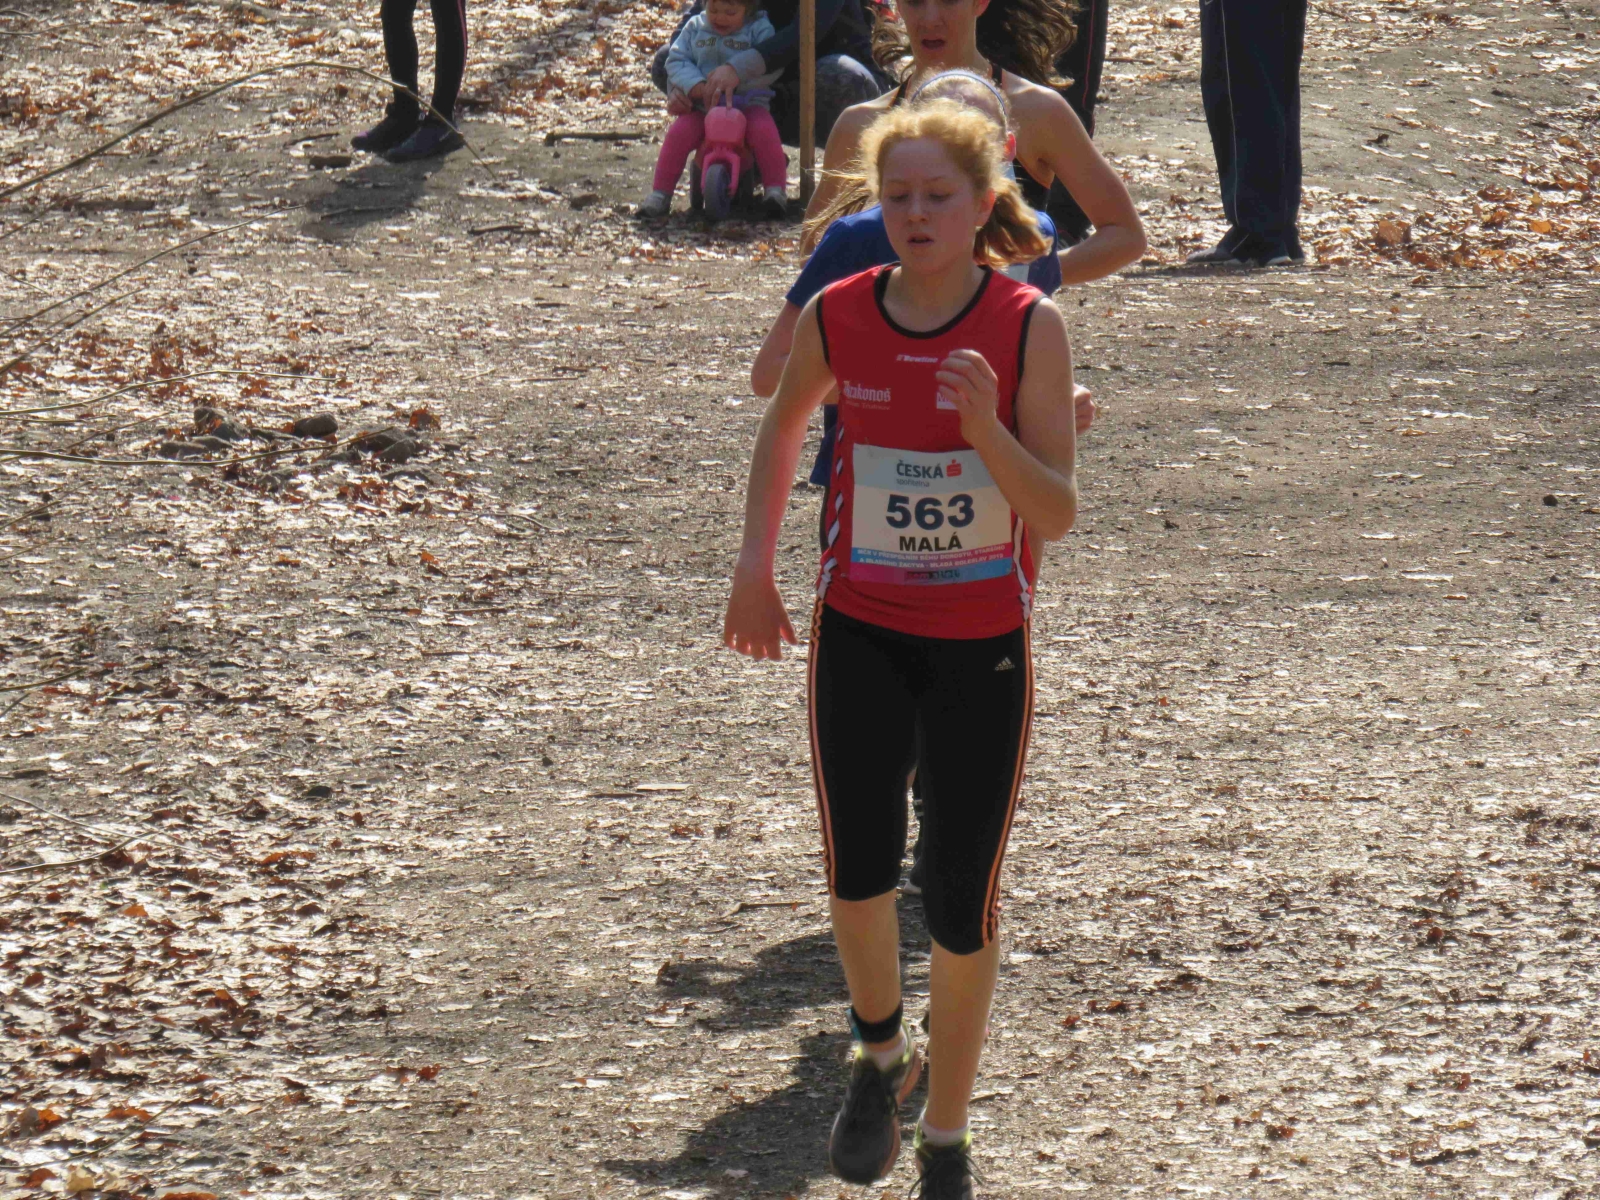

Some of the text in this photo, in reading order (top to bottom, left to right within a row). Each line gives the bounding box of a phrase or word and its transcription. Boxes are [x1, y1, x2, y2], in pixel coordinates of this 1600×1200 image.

[896, 459, 944, 479] ČESKÁ
[896, 478, 931, 488] spořitelna
[886, 494, 975, 530] 563
[899, 531, 963, 552] MALÁ
[919, 552, 939, 561] BĚHU
[954, 556, 987, 567] BOLESLAV
